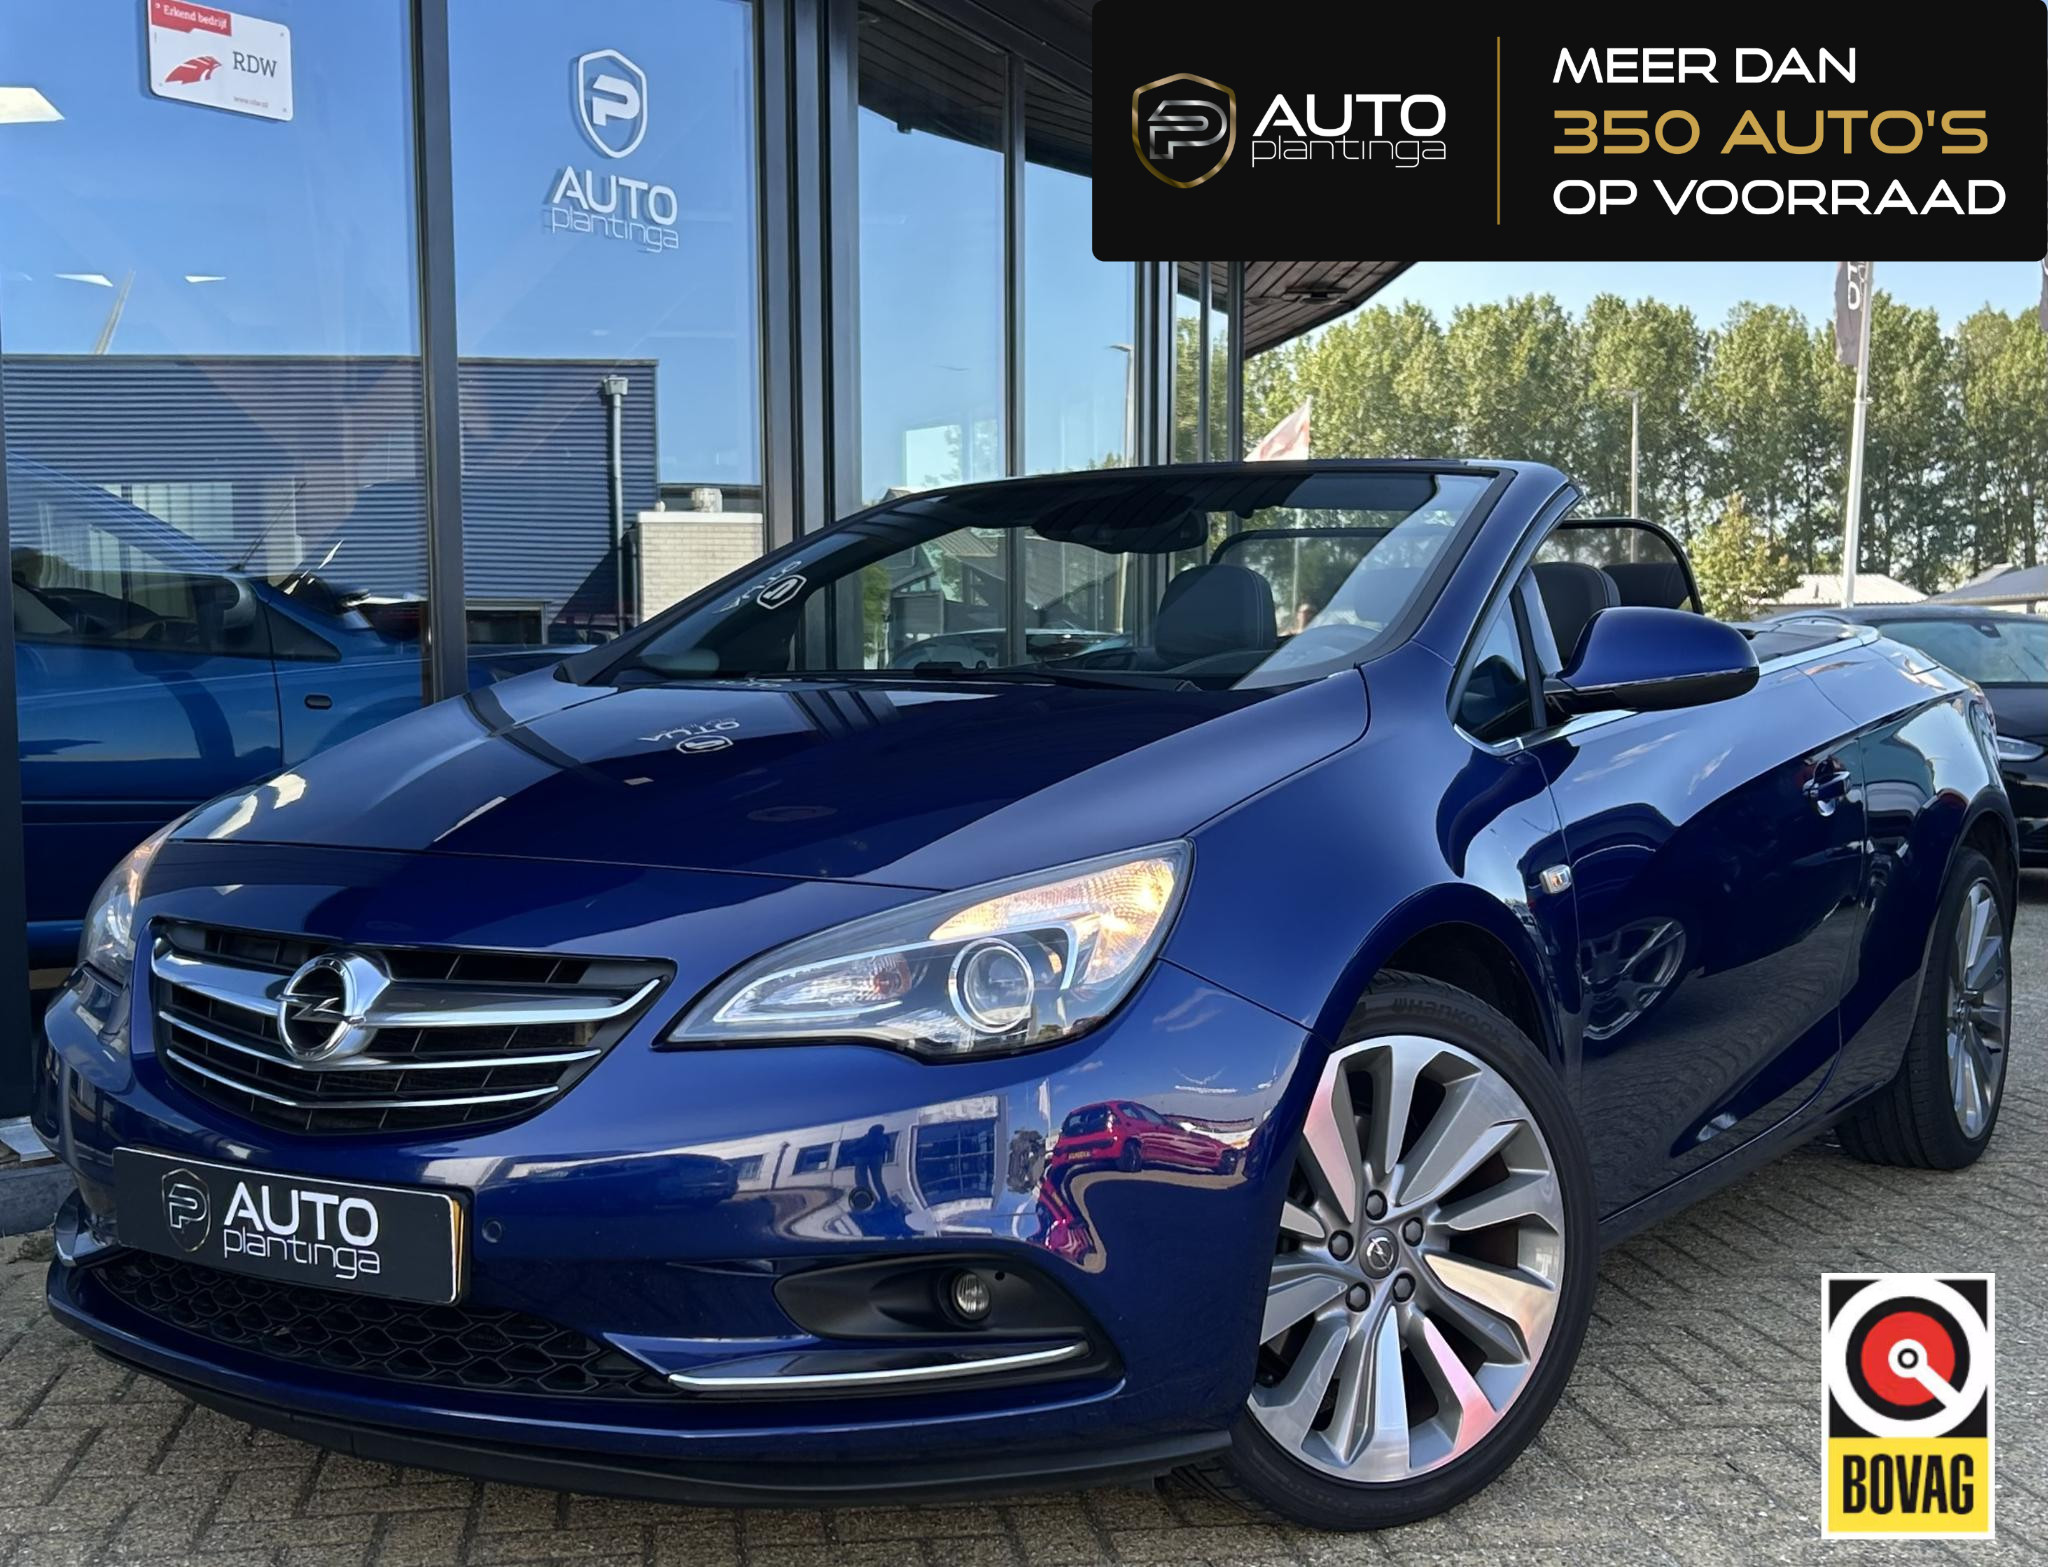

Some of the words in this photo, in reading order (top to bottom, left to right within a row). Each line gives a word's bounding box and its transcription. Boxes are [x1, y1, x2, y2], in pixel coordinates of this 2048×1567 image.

[163, 4, 196, 21] Erkend
[197, 11, 227, 30] bedrijf
[232, 51, 277, 78] RDW
[552, 165, 678, 226] AUTO
[551, 205, 680, 253] plantinga
[223, 1181, 379, 1247] AUTO
[222, 1226, 381, 1279] plantinga
